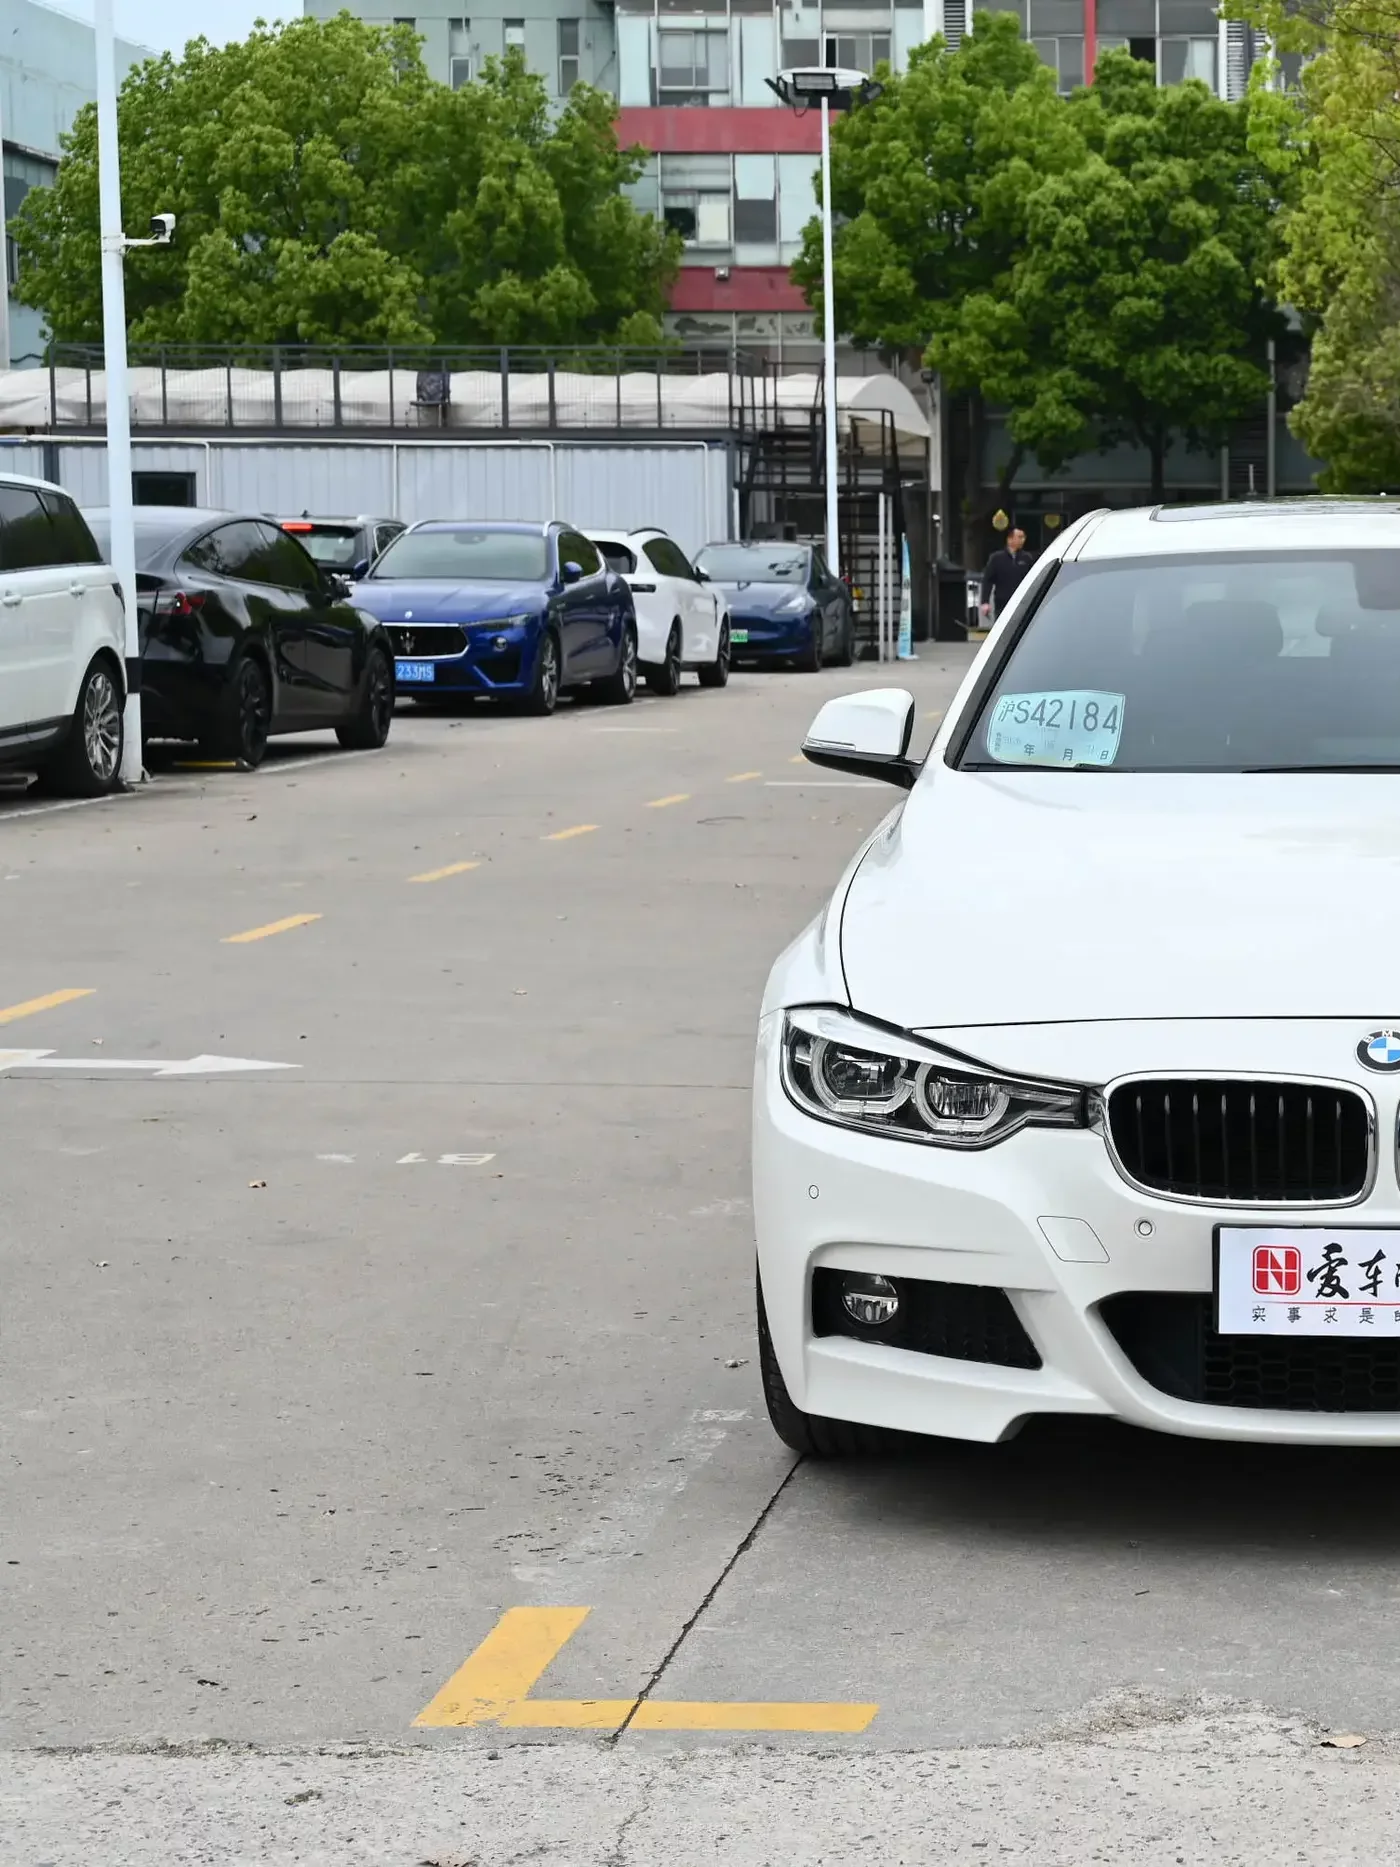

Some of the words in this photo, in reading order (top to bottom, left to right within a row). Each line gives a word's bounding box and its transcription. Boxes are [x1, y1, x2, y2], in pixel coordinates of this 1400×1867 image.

[1024, 743, 1036, 757] 年
[1062, 748, 1074, 761] 月
[1100, 750, 1109, 760] 日
